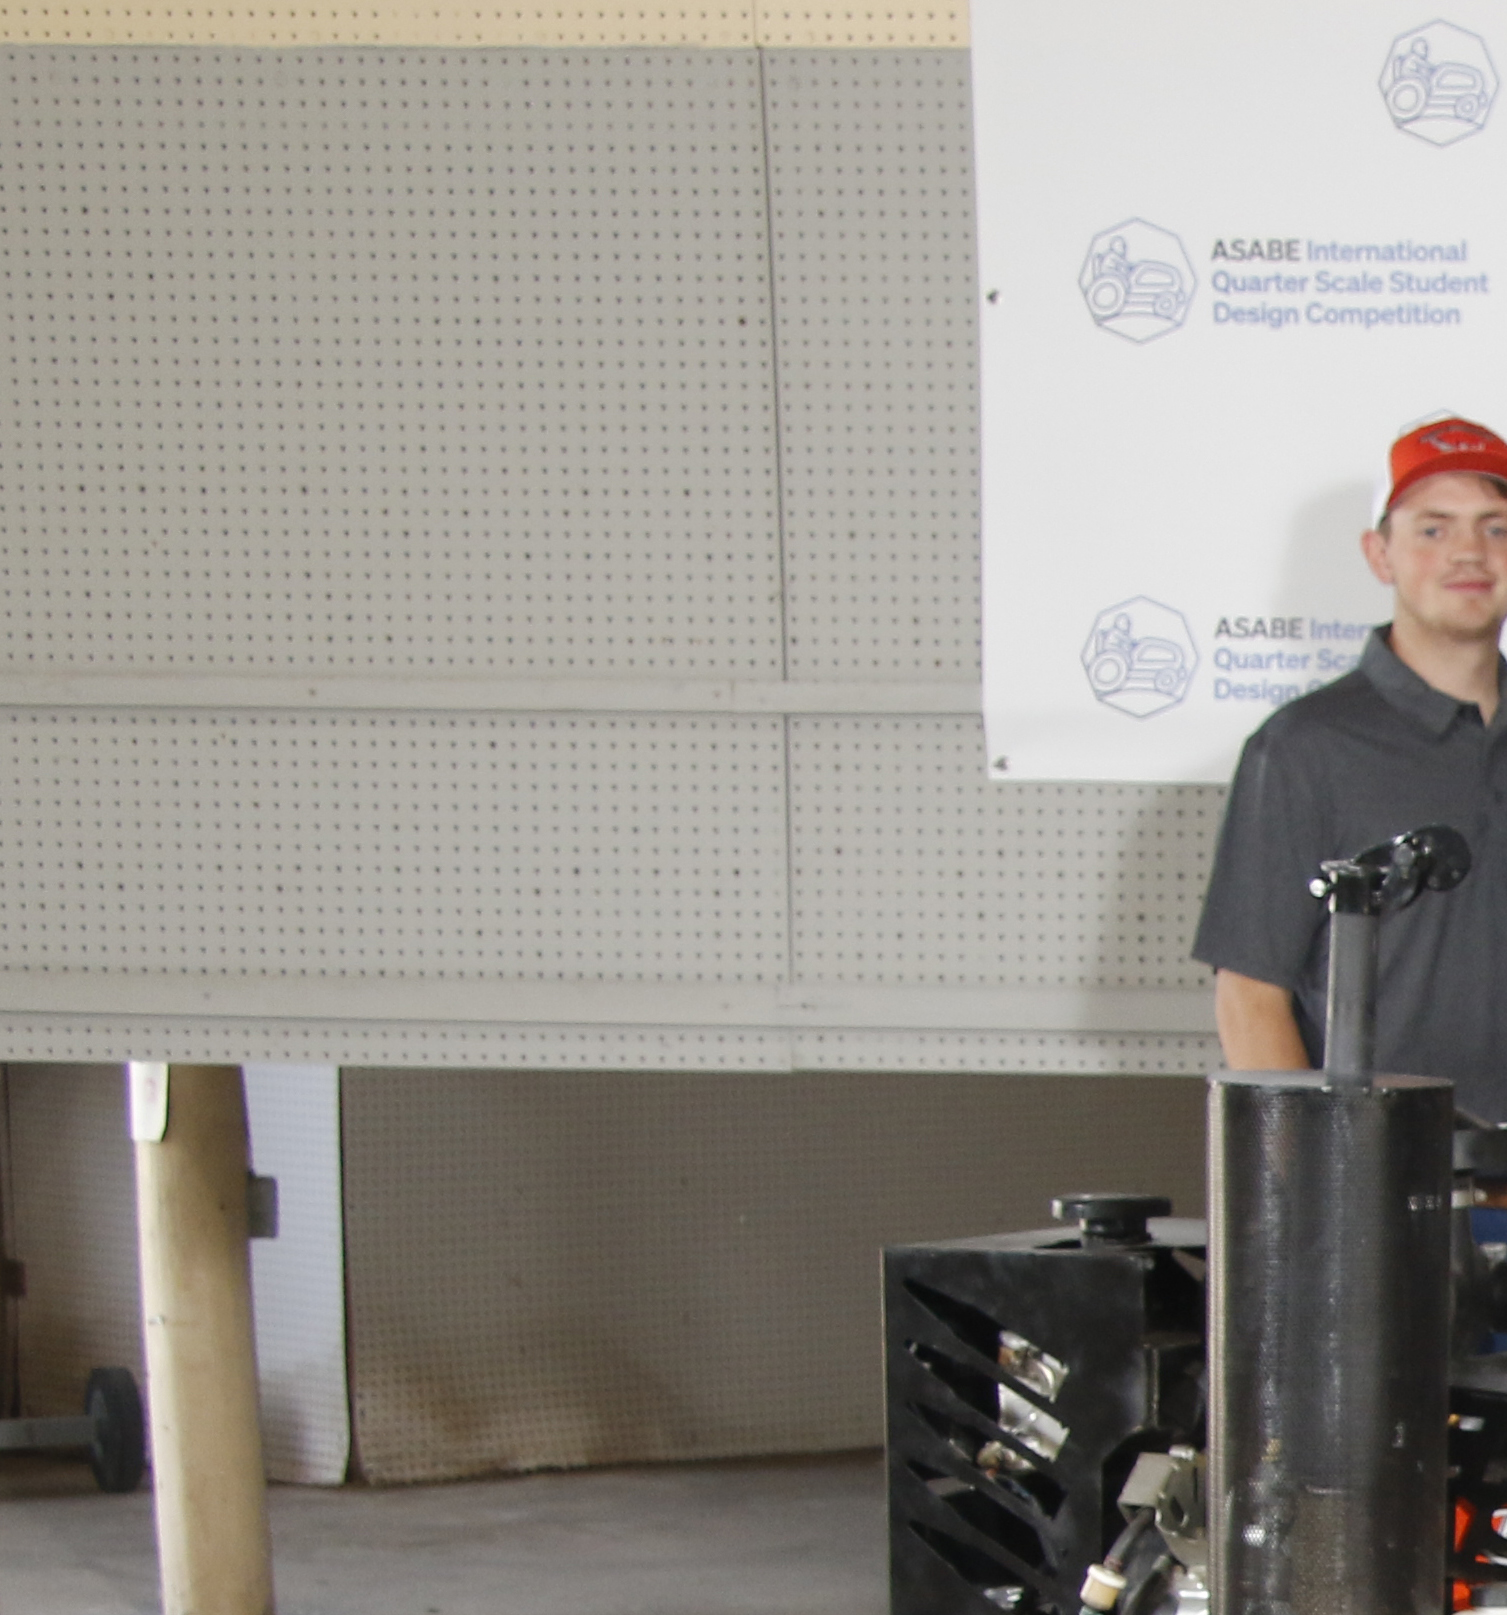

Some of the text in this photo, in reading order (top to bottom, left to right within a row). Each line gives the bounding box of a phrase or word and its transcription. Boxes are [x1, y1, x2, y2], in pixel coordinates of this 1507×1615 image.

[1210, 238, 1467, 262] ASABE International
[1211, 269, 1488, 295] Quarter Scale Student
[1213, 301, 1461, 329] Design Competition
[1214, 616, 1304, 639] ASABE
[1213, 647, 1311, 671] Quarter
